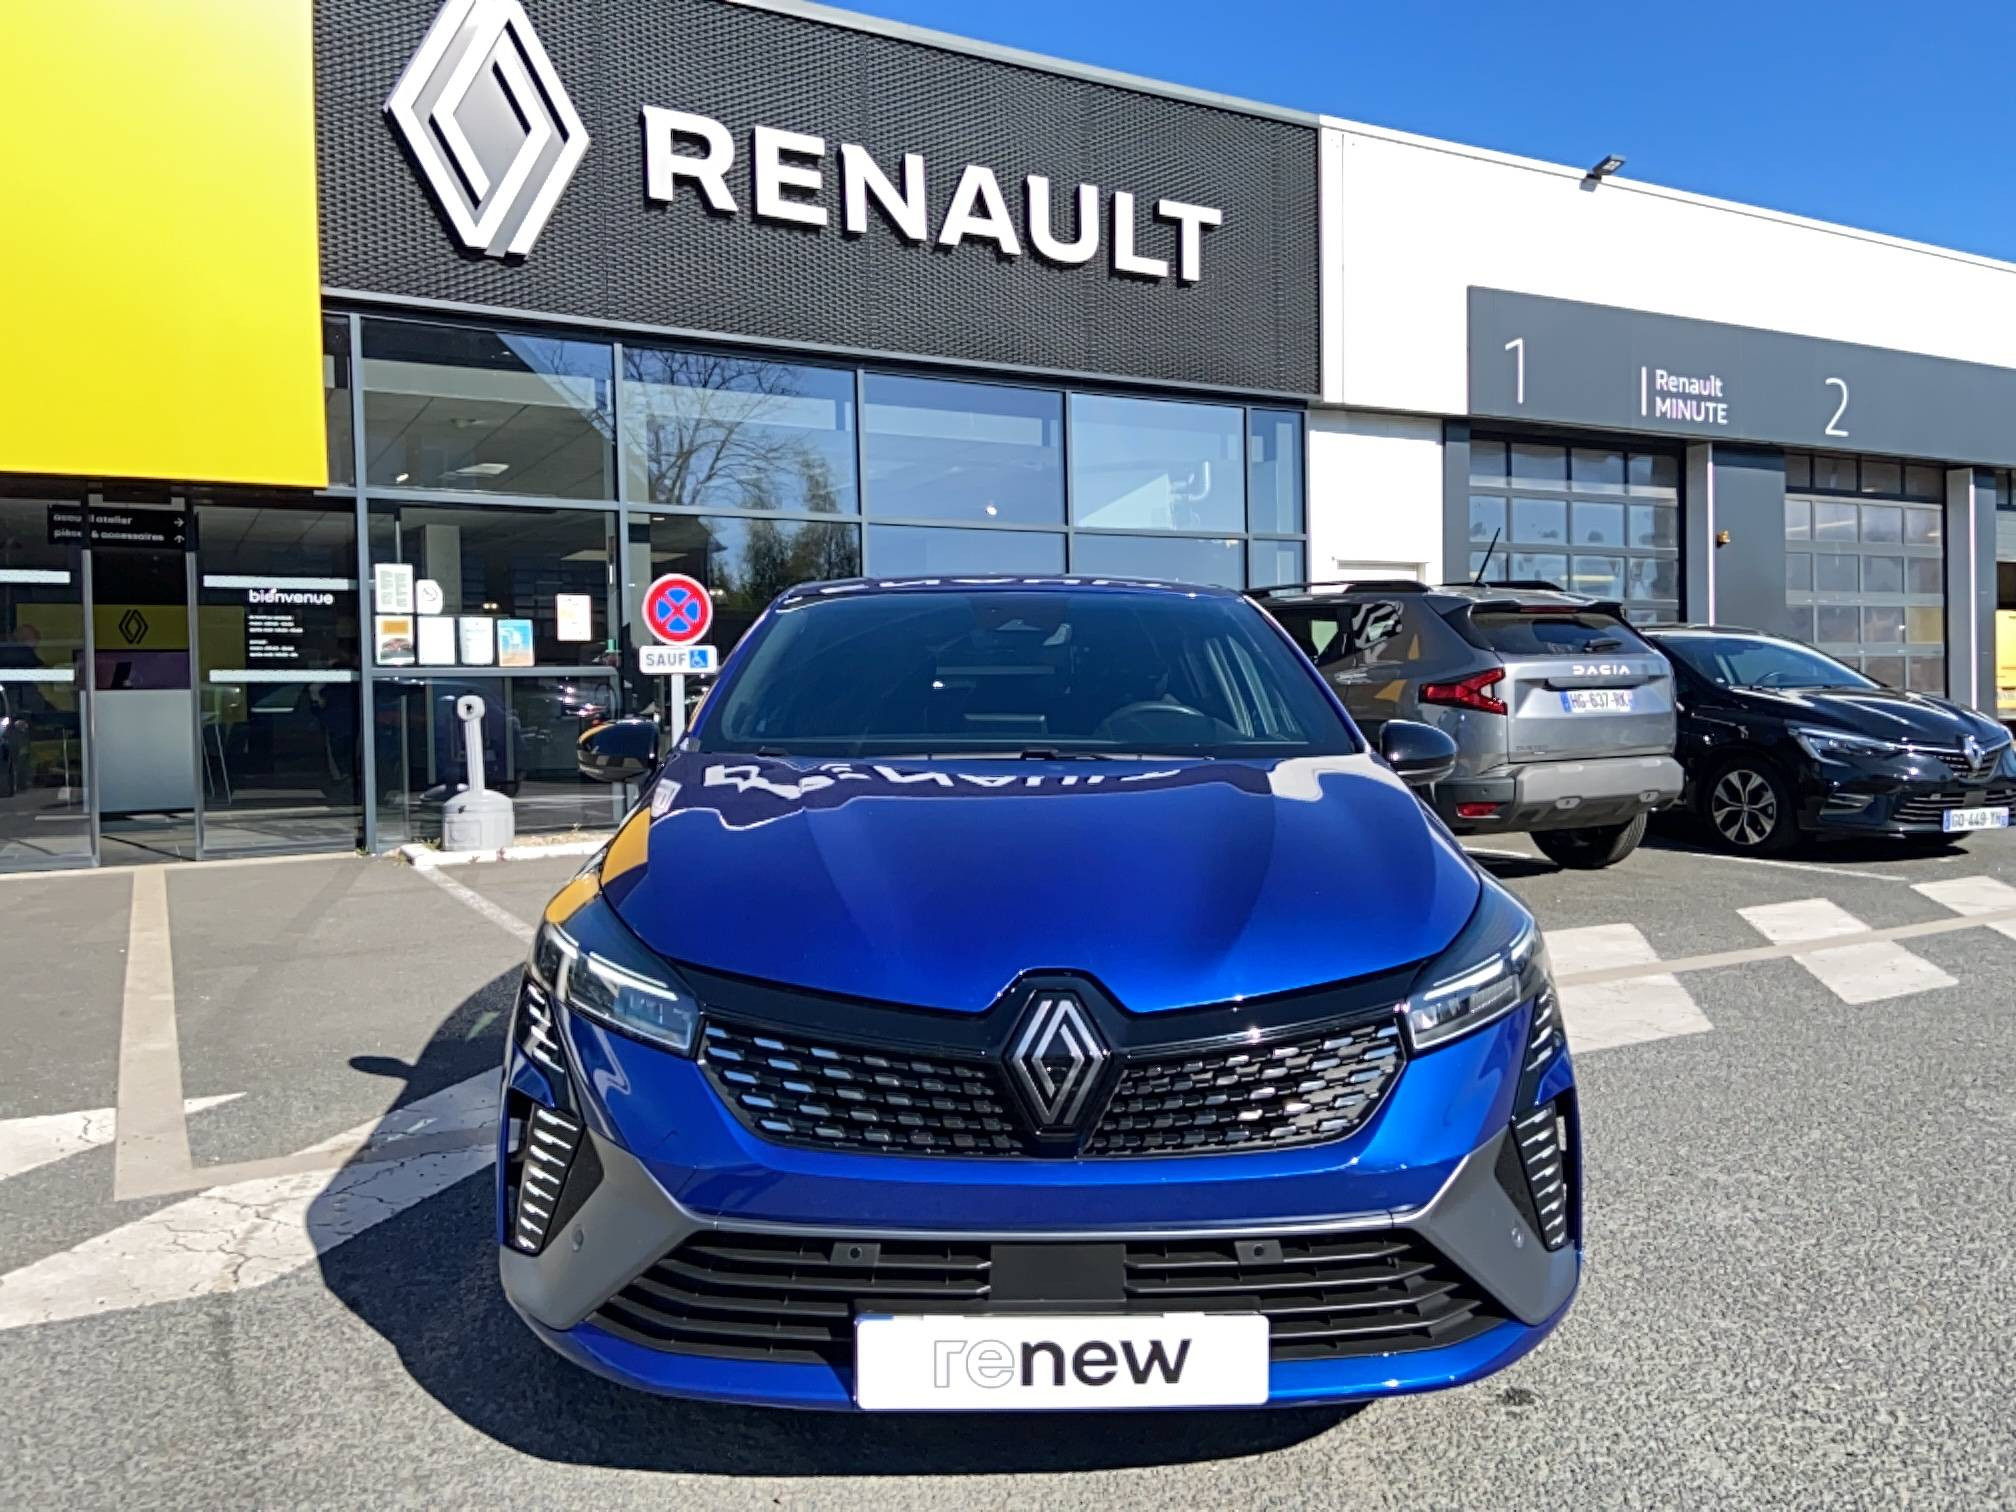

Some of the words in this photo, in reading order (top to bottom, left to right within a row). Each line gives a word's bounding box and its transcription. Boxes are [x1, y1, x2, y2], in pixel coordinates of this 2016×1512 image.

[642, 104, 1223, 282] RENAULT
[1504, 337, 1525, 405] 1
[1655, 368, 1723, 397] Renault
[1655, 396, 1728, 424] MINUTE
[1824, 377, 1850, 438] 2
[96, 514, 133, 525] atelier
[101, 531, 164, 542] accessoires
[249, 588, 334, 605] bienvenue
[646, 653, 687, 666] SAUF
[1572, 664, 1631, 676] DACIA
[933, 1337, 1192, 1389] renew
